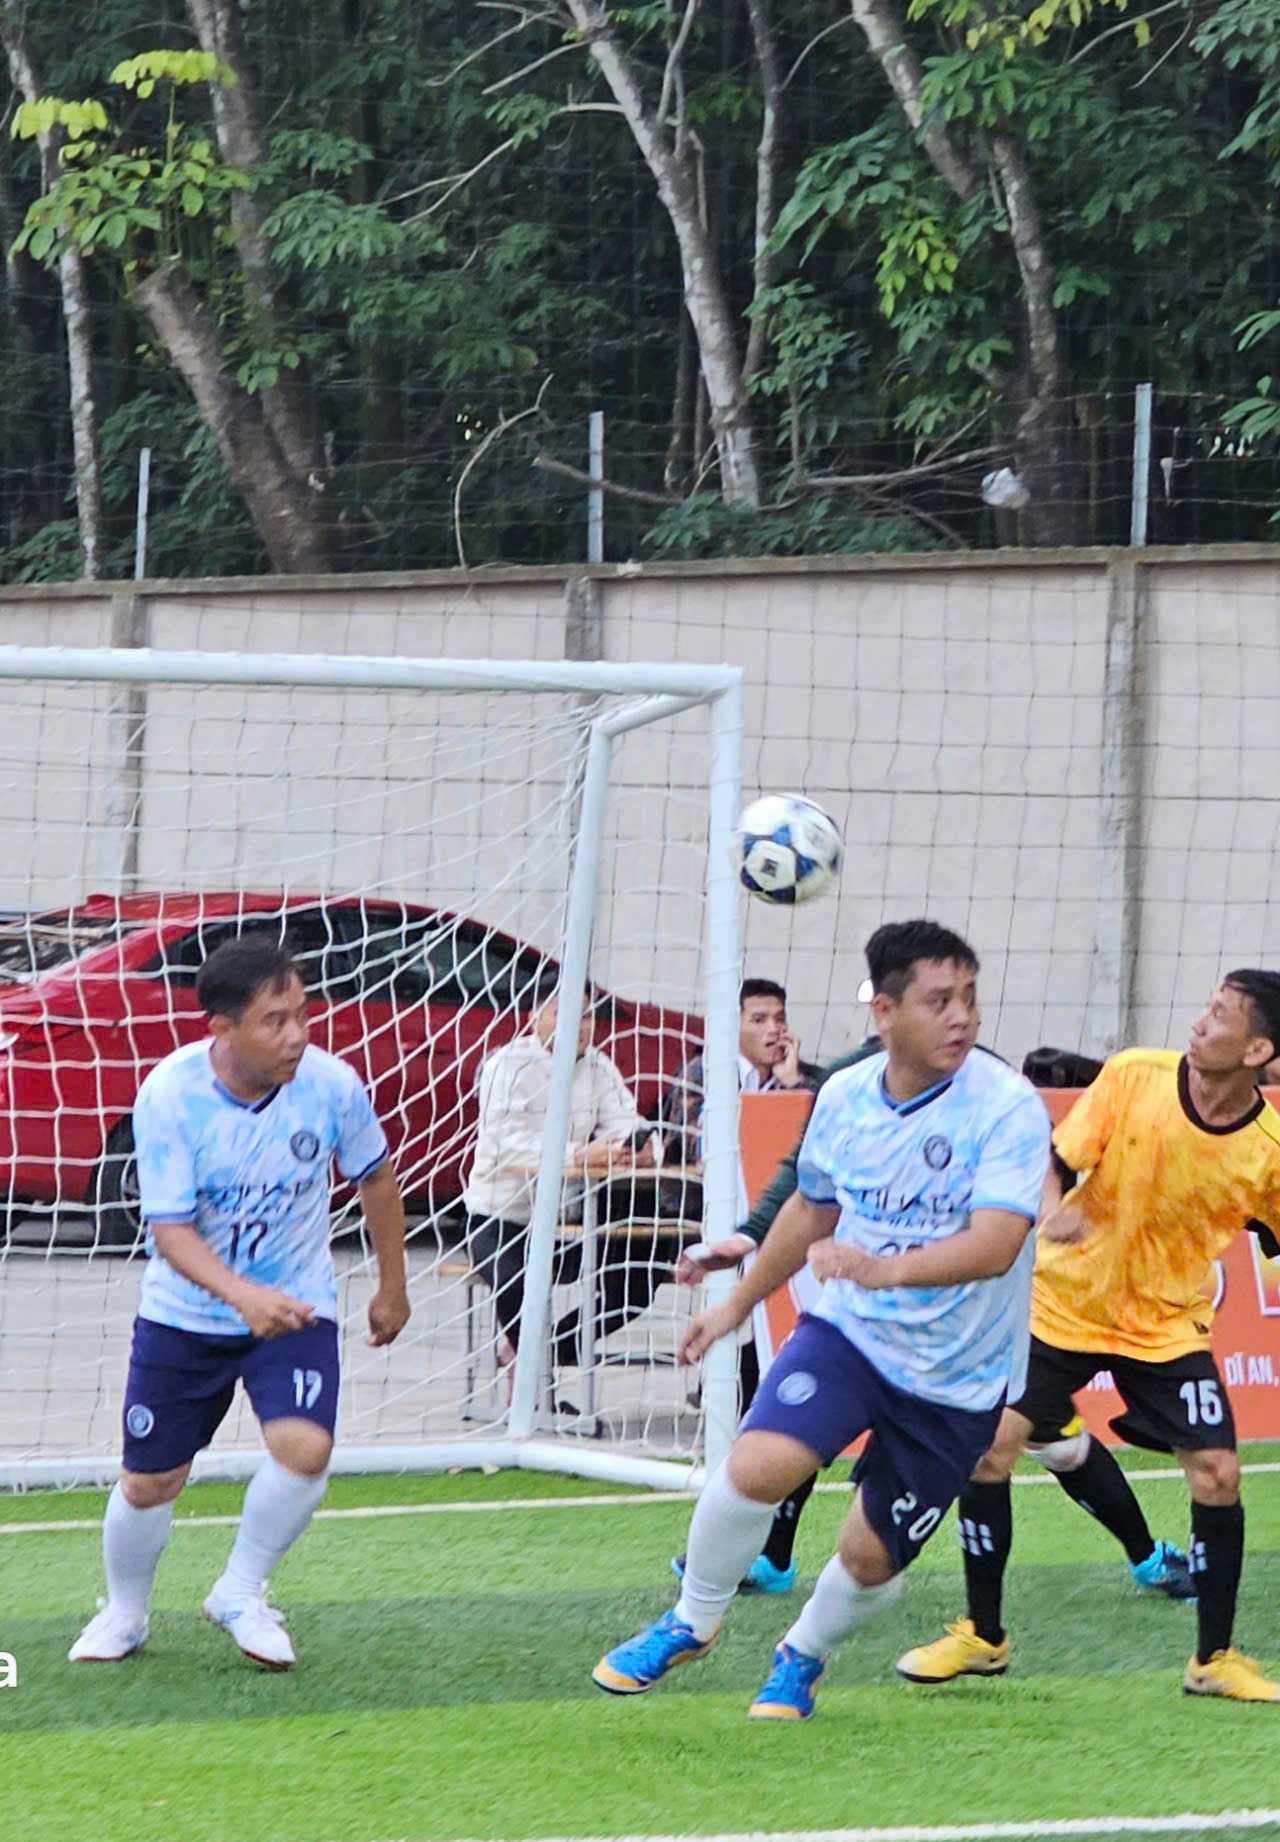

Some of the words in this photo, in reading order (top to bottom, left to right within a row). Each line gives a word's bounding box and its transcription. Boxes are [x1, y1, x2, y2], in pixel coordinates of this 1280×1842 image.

[229, 1220, 268, 1263] 17
[292, 1367, 323, 1410] 17
[1179, 1380, 1224, 1426] 15
[891, 1491, 941, 1541] 20
